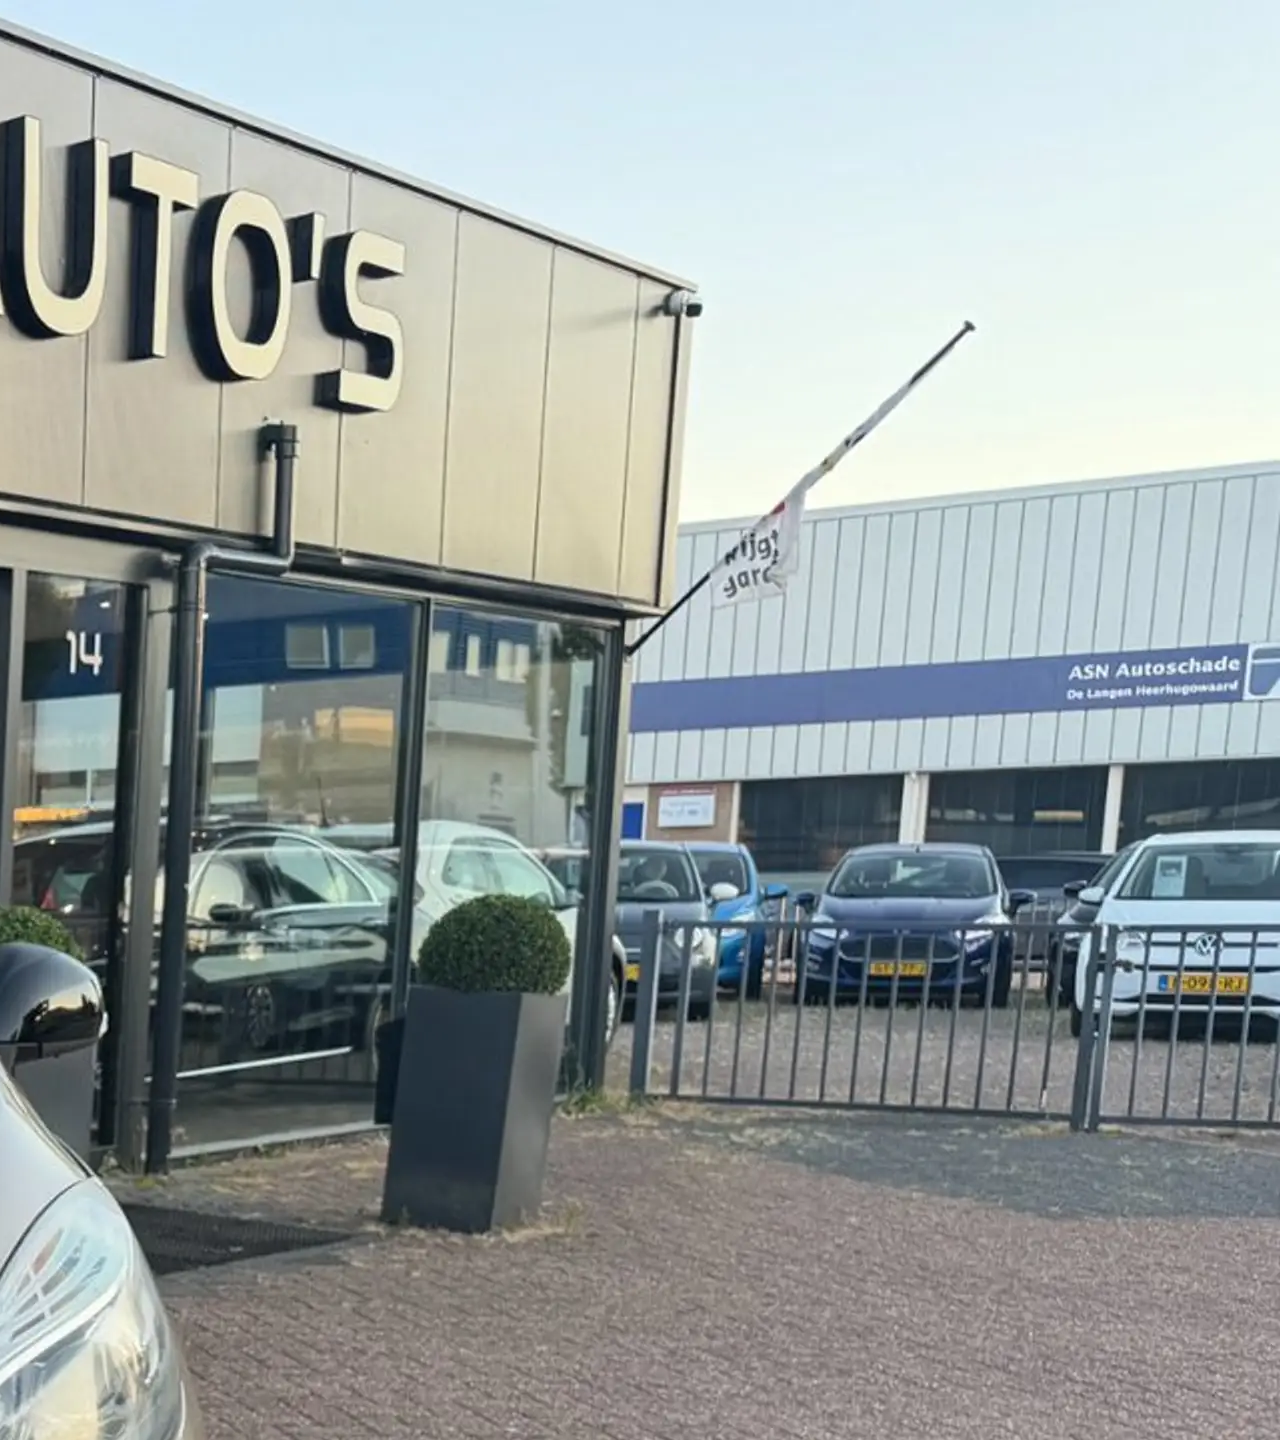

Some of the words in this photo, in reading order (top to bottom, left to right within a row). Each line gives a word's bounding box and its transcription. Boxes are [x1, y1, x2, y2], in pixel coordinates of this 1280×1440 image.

[65, 630, 104, 676] 14
[1068, 663, 1110, 681] ASN
[1115, 656, 1241, 679] Autoschade
